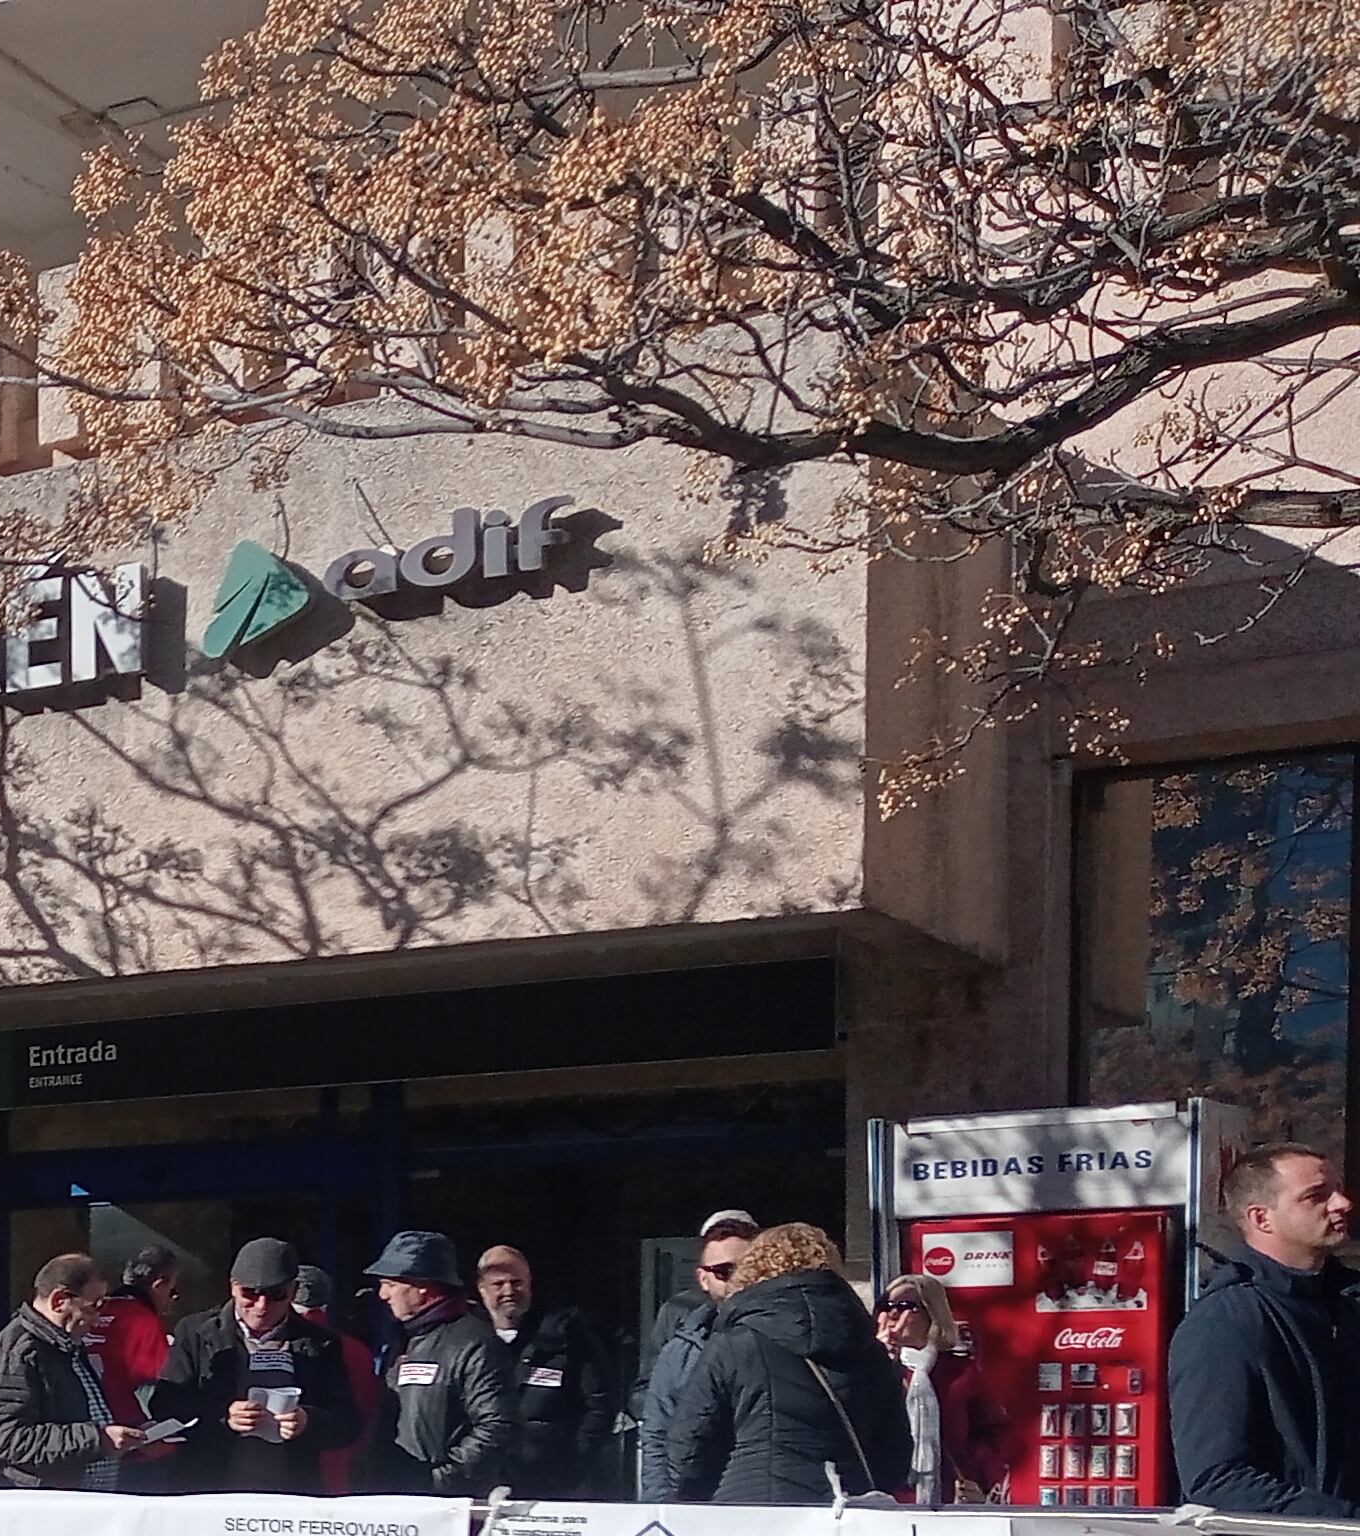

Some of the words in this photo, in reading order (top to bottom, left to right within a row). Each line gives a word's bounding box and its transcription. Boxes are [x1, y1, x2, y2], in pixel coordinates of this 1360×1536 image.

[323, 494, 576, 601] adif
[29, 1040, 118, 1067] Entrada
[29, 1073, 83, 1088] ENTRANCE
[912, 1155, 1044, 1181] BEBIDAS
[1056, 1149, 1153, 1172] FRIAS
[224, 1517, 294, 1534] SECTOR
